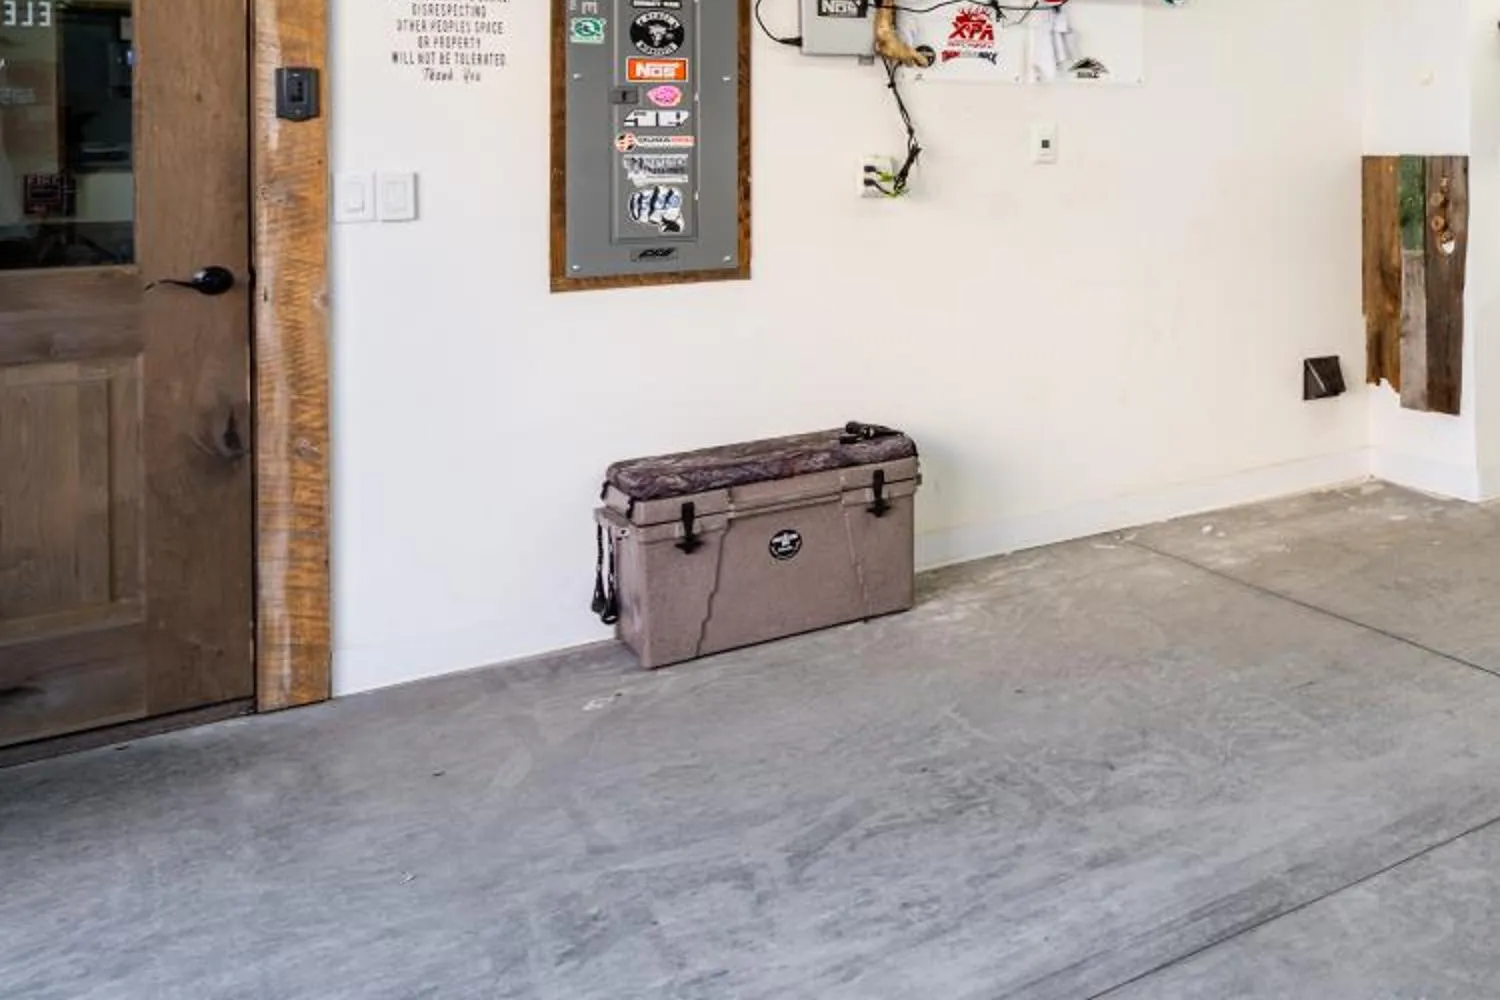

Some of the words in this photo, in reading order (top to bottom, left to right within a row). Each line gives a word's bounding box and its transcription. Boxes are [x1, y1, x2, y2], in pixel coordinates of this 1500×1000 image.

[433, 36, 481, 49] PROPERTY
[417, 51, 435, 64] NOT
[454, 51, 506, 67] TOLERATED
